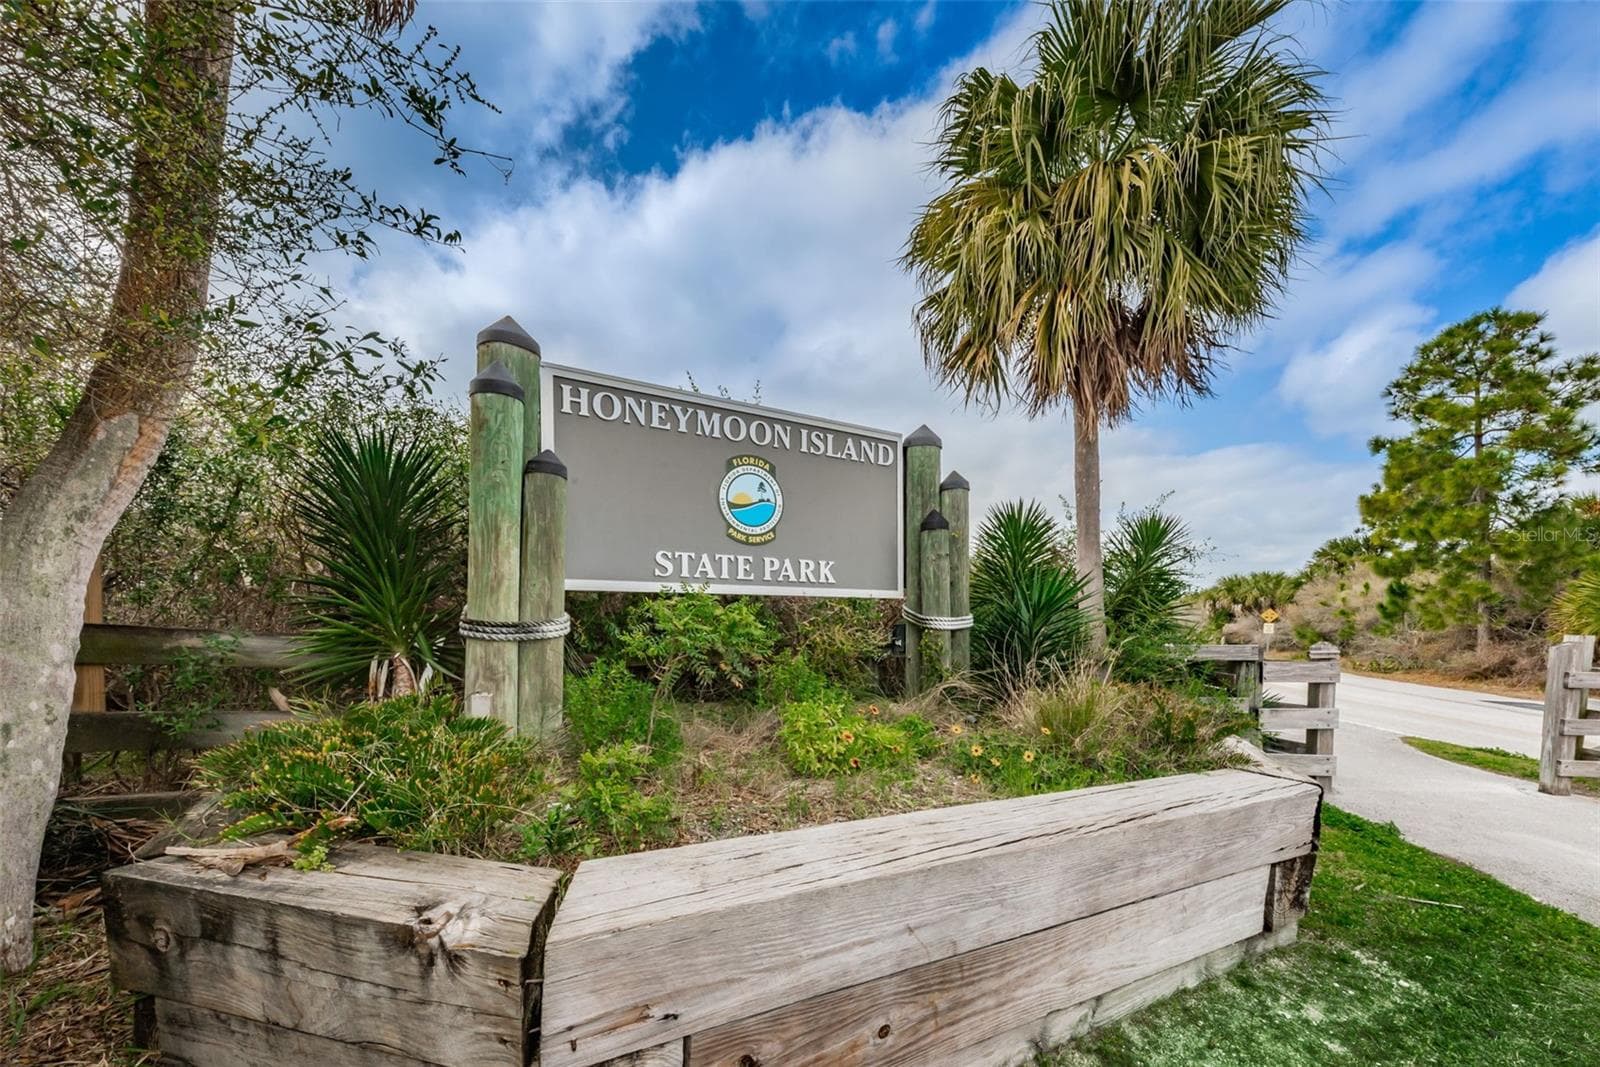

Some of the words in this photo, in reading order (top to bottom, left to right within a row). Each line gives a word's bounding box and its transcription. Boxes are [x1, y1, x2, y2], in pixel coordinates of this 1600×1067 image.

[559, 383, 792, 450] HONEYMOON
[800, 428, 895, 467] ISLAND
[732, 457, 770, 471] FLORIDA
[728, 528, 747, 543] PARK
[748, 531, 775, 543] SERVICE
[654, 550, 754, 580] STATE
[763, 556, 836, 584] PARK
